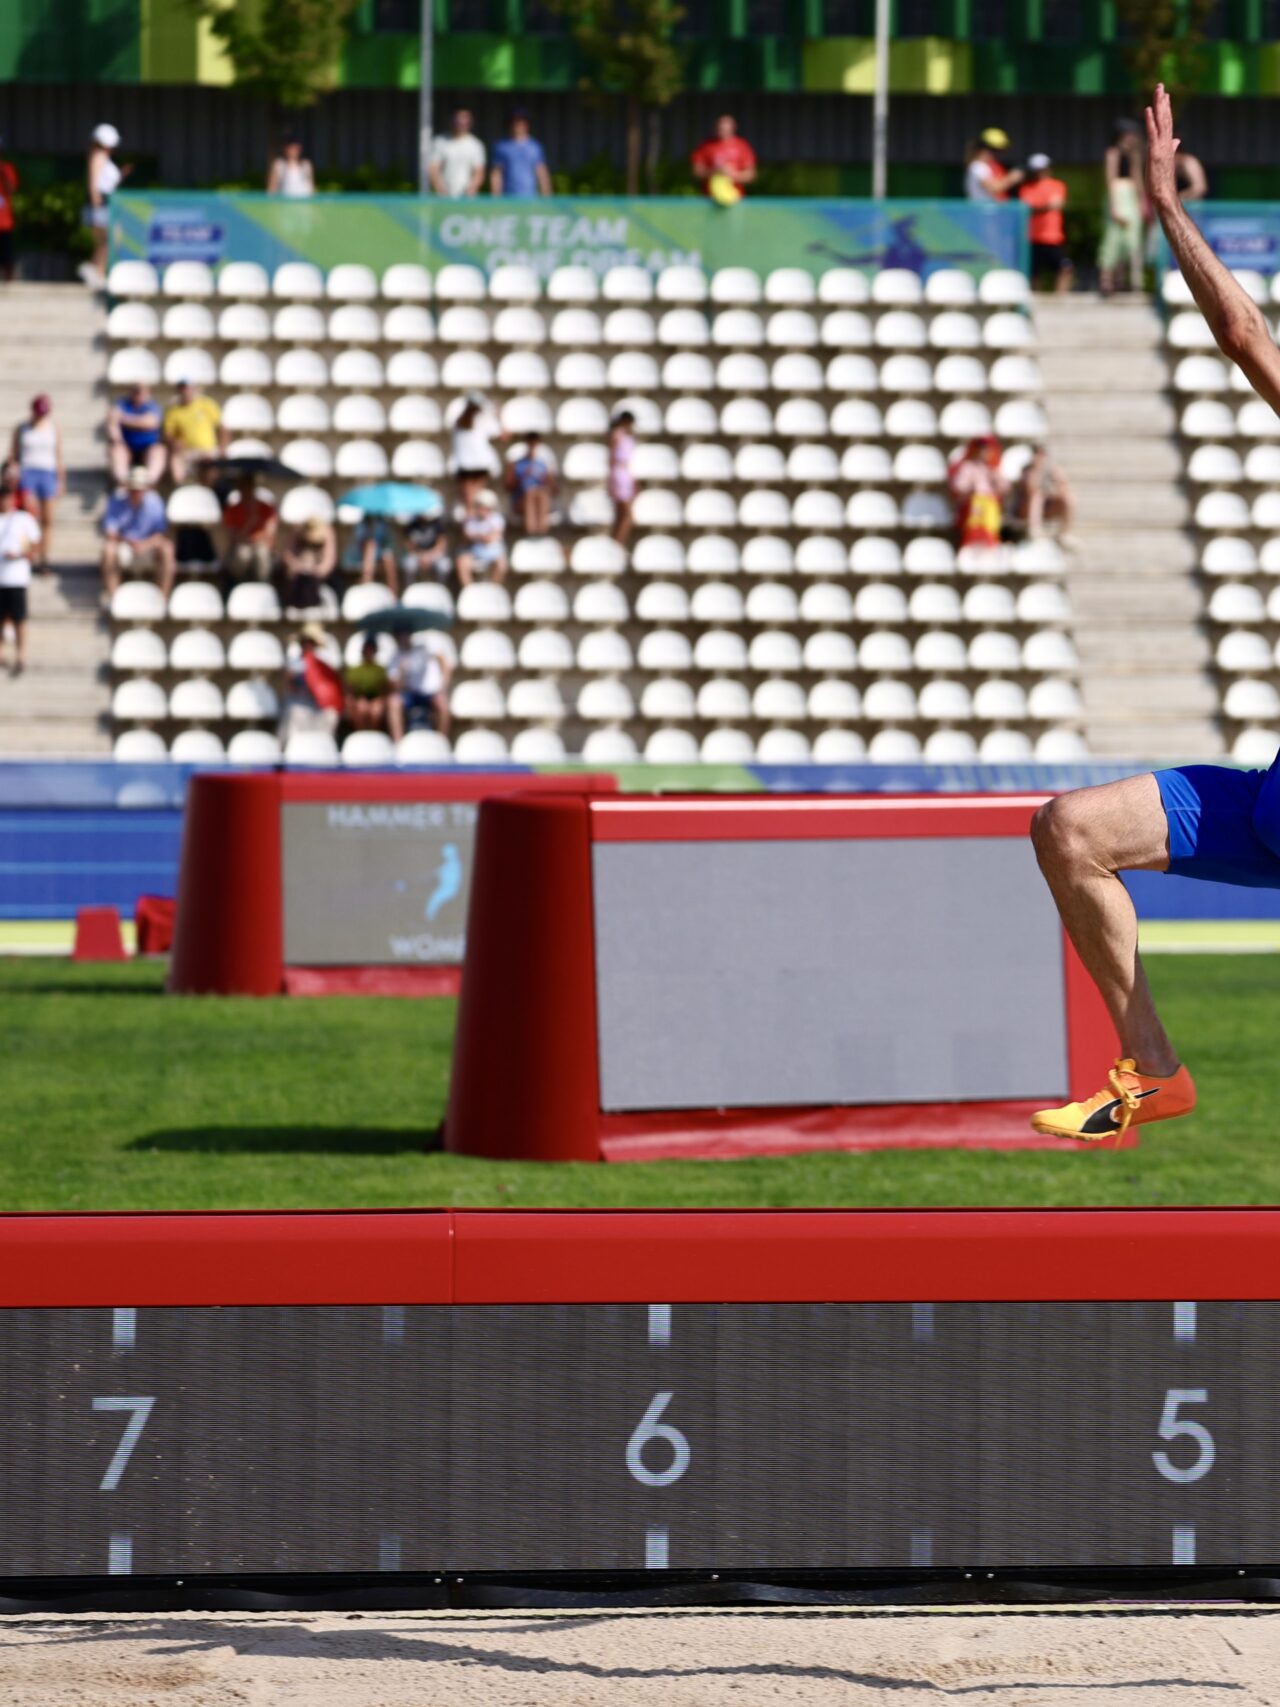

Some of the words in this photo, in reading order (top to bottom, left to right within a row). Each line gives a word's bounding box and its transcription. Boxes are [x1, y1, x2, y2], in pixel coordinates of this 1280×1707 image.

[439, 214, 517, 247] ONE
[526, 216, 628, 245] TEAM
[328, 804, 446, 829] HAMMER
[92, 1397, 156, 1490] 7
[625, 1392, 691, 1486] 6
[1152, 1389, 1216, 1483] 5
